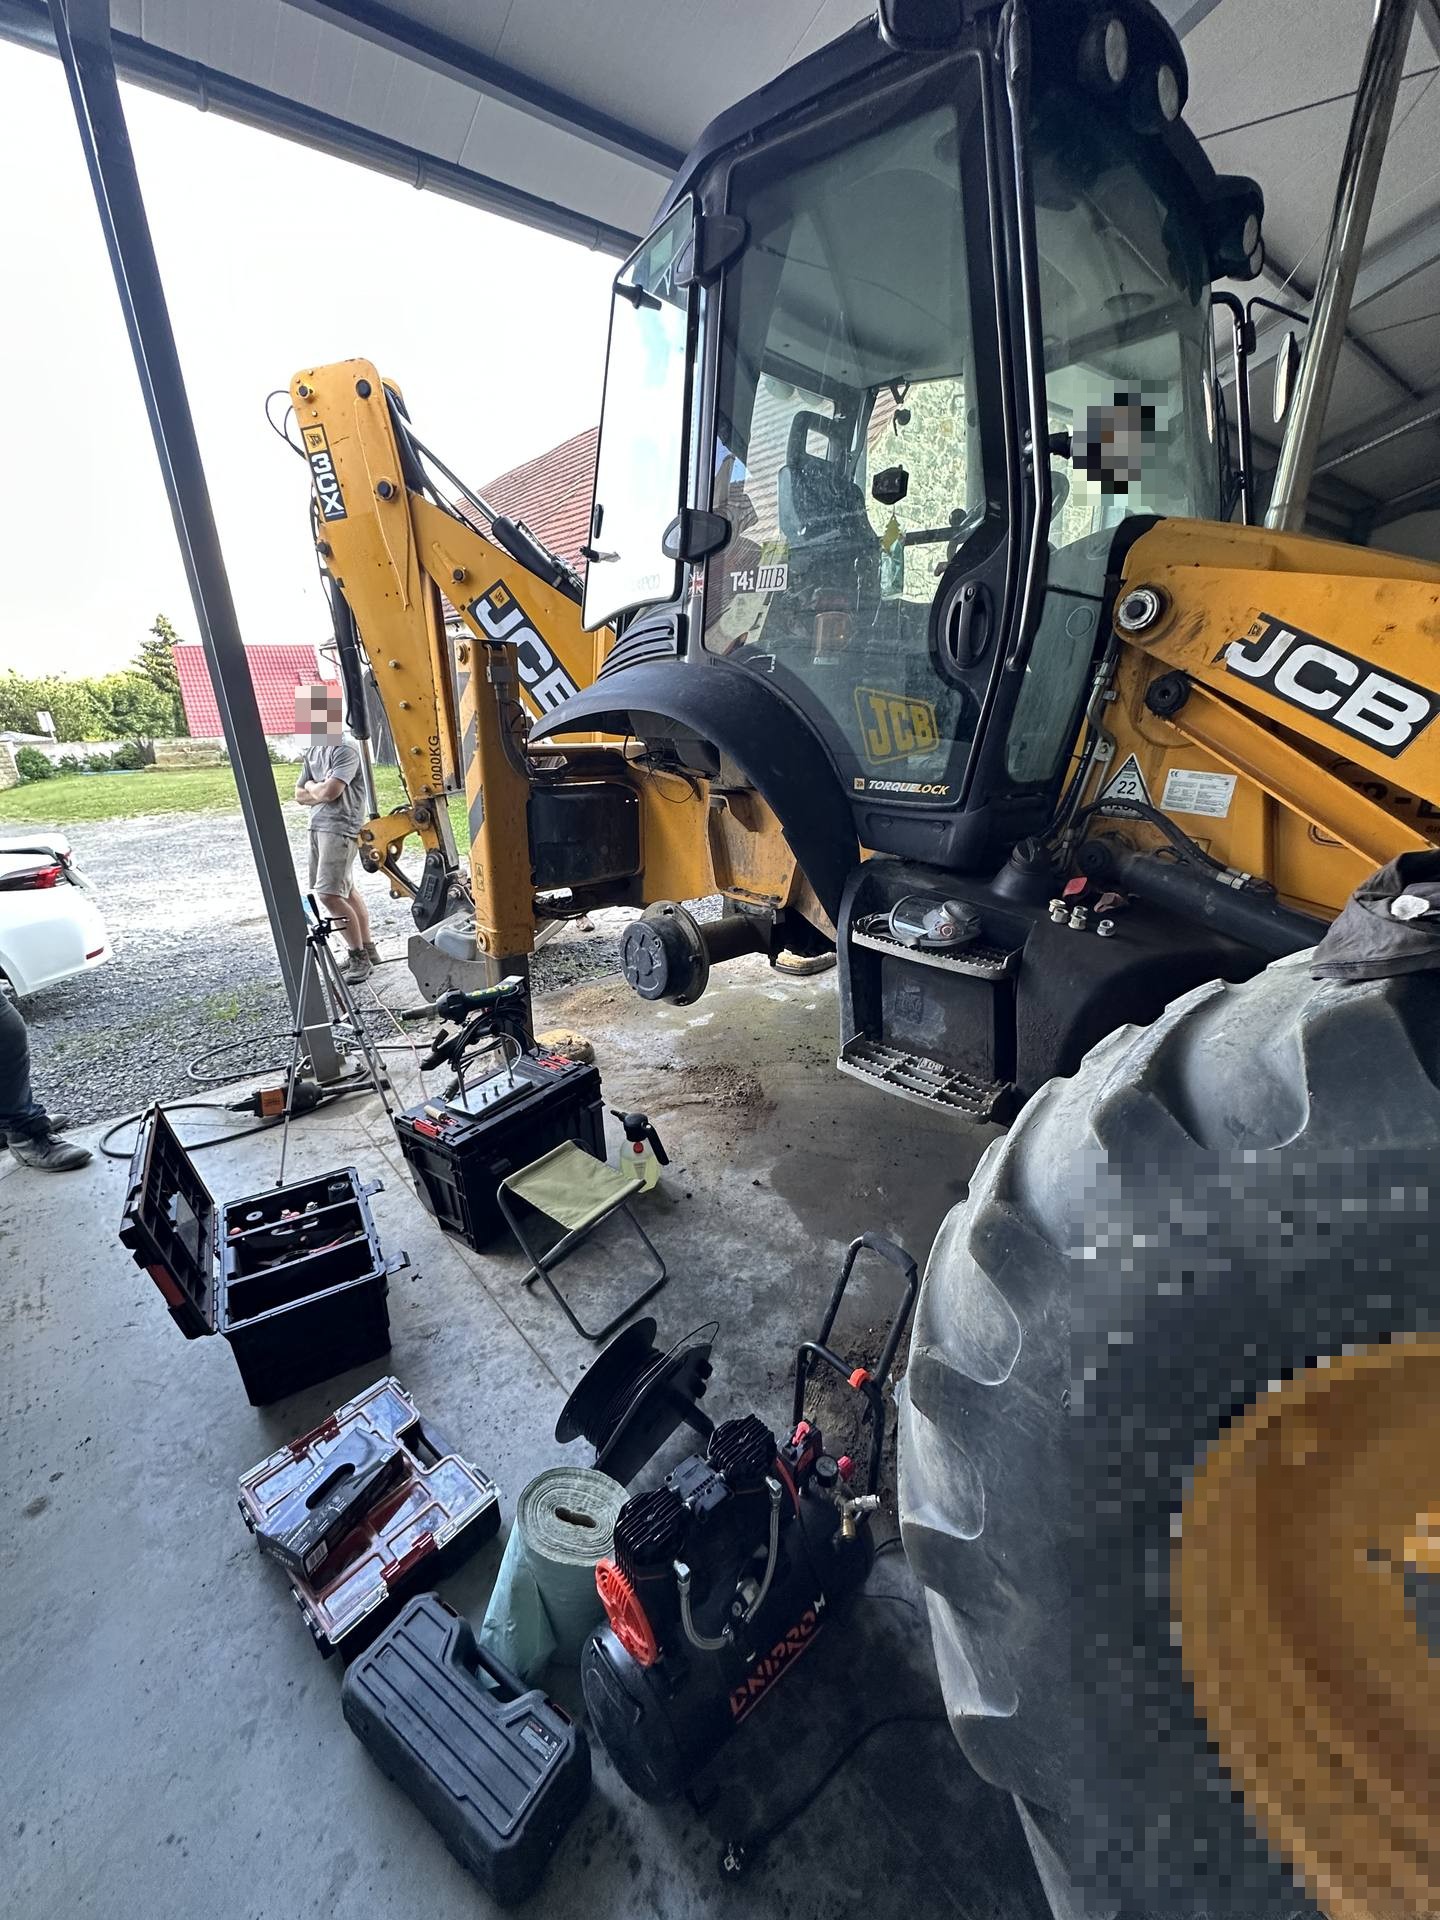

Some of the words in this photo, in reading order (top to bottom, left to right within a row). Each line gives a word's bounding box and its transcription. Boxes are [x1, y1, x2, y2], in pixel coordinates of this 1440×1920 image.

[311, 452, 345, 514] 3CX
[730, 571, 755, 592] T4i
[1224, 629, 1431, 747] JCB
[868, 696, 934, 756] JCB
[427, 734, 442, 789] 1000KG
[868, 779, 951, 796] TORQUELOCK
[1116, 780, 1137, 795] 22
[292, 1466, 325, 1500] 4GRIP
